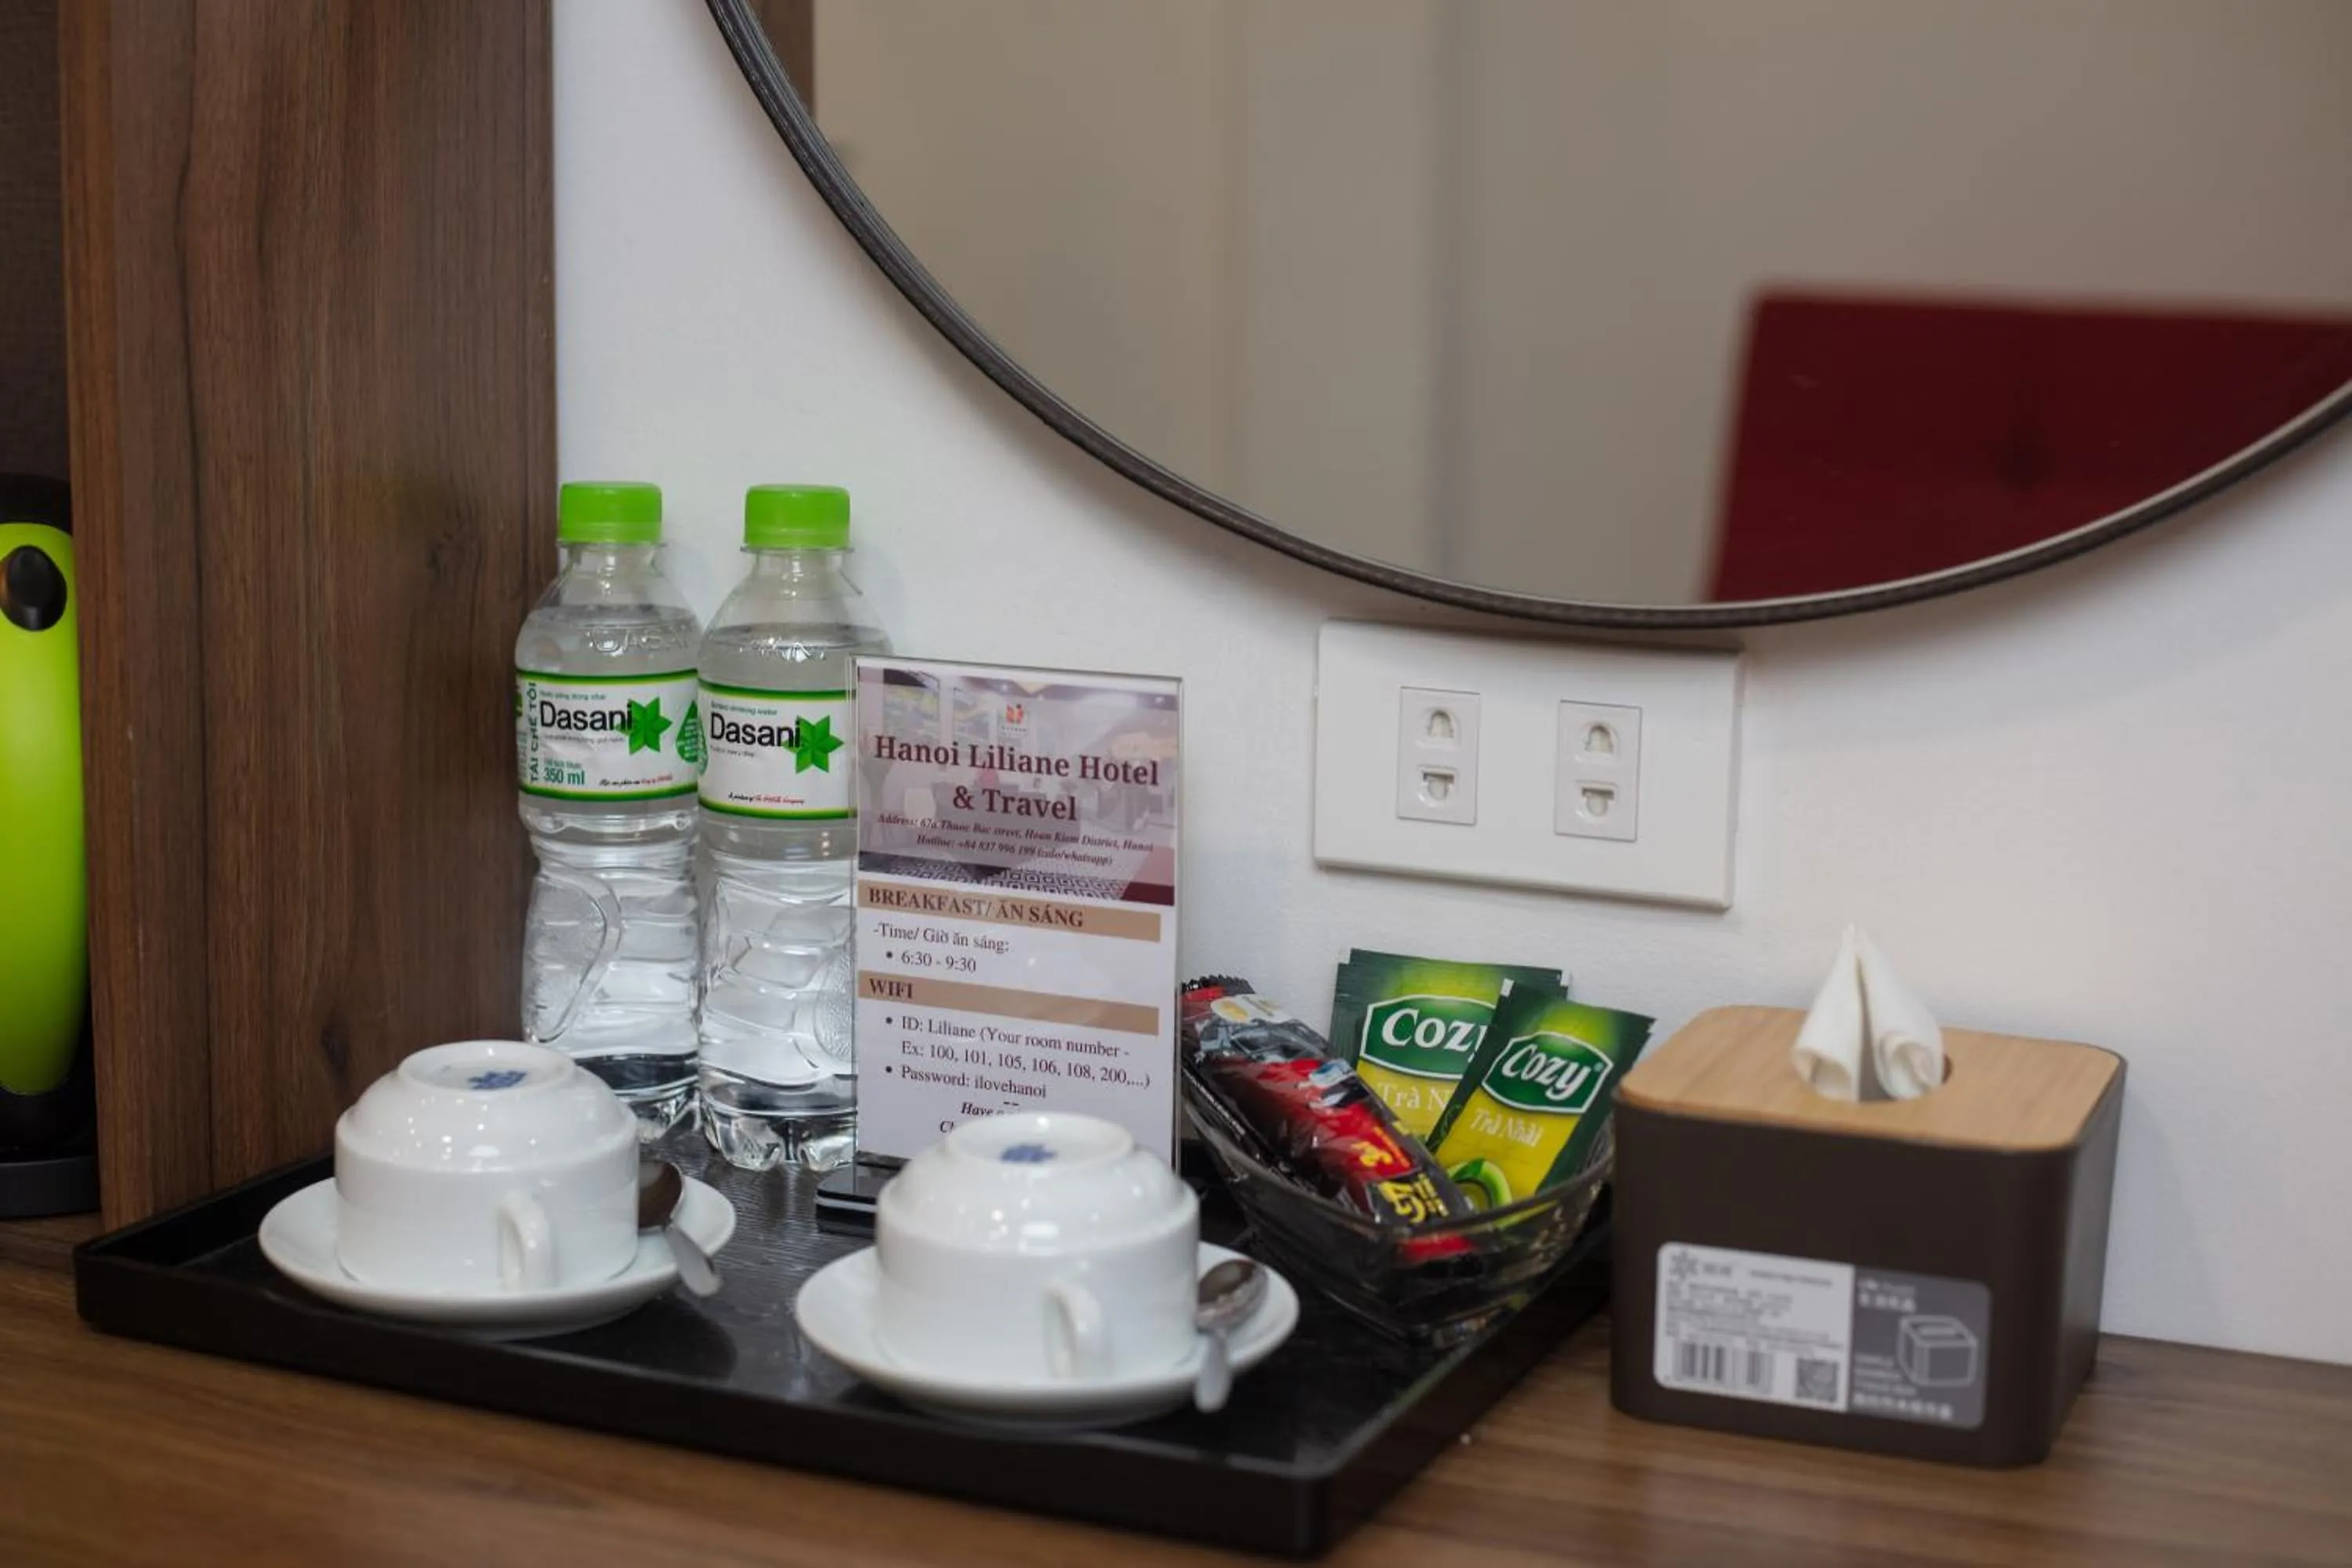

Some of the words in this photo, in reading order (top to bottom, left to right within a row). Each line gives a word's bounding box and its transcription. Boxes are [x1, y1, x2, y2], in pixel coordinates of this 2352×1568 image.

[539, 699, 633, 731] Dasani
[710, 711, 801, 748] Dasani
[873, 735, 960, 766] Hanoi
[967, 744, 1069, 778] Liliane
[1079, 754, 1160, 786] Hotel
[543, 768, 564, 784] 350
[567, 769, 586, 786] ml
[953, 785, 975, 811] &
[982, 788, 1078, 821] Travel
[877, 814, 918, 826] Address:
[1025, 828, 1051, 840] Hoan
[1054, 831, 1080, 844] Kiem
[1082, 834, 1120, 849] District,
[1122, 839, 1154, 852] Hanoi
[916, 833, 955, 848] Hotline:
[956, 838, 976, 850] +84
[868, 887, 993, 916] BREAKFAST/
[995, 900, 1024, 921] ĂN
[1028, 903, 1083, 928] SÁNG
[923, 927, 949, 944] Giờ
[952, 931, 969, 947] ăn
[973, 935, 1010, 955] sáng:
[902, 949, 933, 967] 6:30
[945, 955, 977, 974] 9:30
[869, 978, 913, 999] WIFI
[902, 1015, 924, 1032] ID:
[927, 1018, 976, 1039] Liliane
[979, 1025, 1022, 1045] (Your
[1025, 1034, 1062, 1050] room
[1065, 1040, 1122, 1058] number
[902, 1040, 924, 1057] Ex:
[930, 1044, 959, 1062] 100,
[964, 1048, 992, 1067] 101,
[998, 1052, 1027, 1073] 105,
[1031, 1058, 1061, 1076] 106,
[1066, 1062, 1096, 1081] 108,
[1501, 1043, 1592, 1102] Cozy
[901, 1065, 971, 1087] Password:
[975, 1074, 1047, 1098] ilovehanoi
[1377, 1081, 1421, 1109] Trà
[960, 1101, 994, 1117] Have
[1471, 1107, 1502, 1136] Trà
